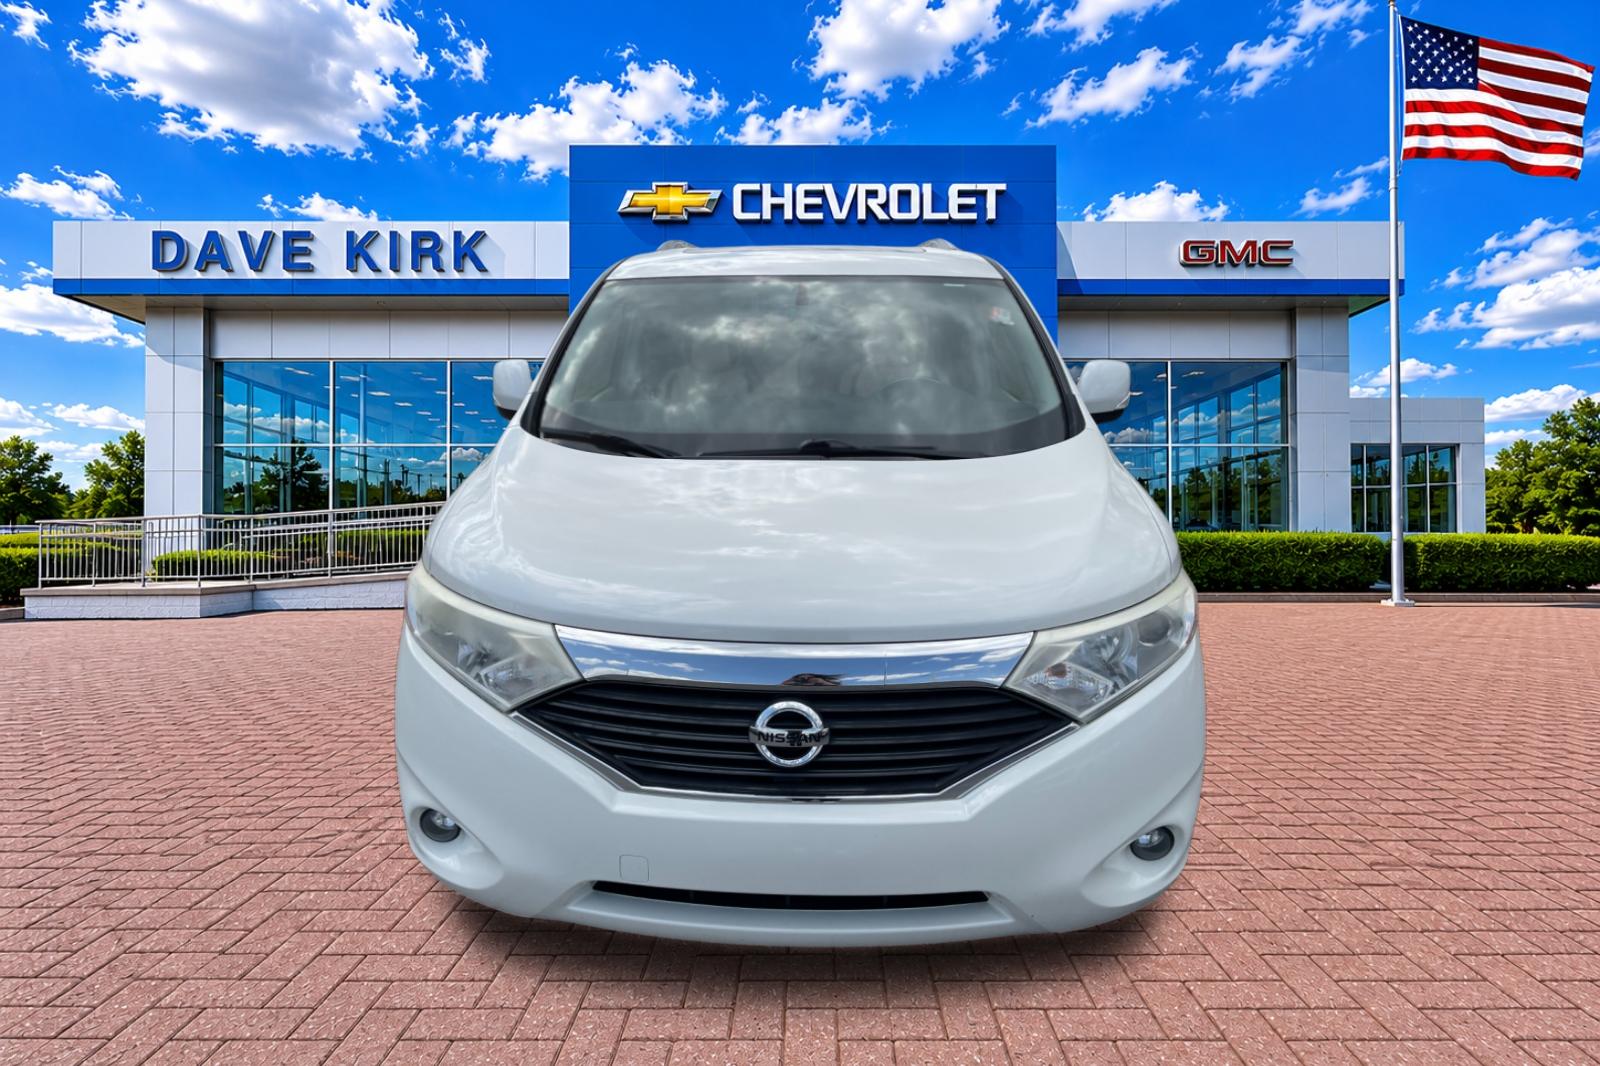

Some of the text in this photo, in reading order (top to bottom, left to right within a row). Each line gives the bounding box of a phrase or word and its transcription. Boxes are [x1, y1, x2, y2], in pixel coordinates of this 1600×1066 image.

[732, 182, 1007, 223] CHEVROLET
[151, 229, 488, 273] DAVE KIRK
[1179, 239, 1295, 267] GMC
[757, 731, 821, 744] NISSAN
